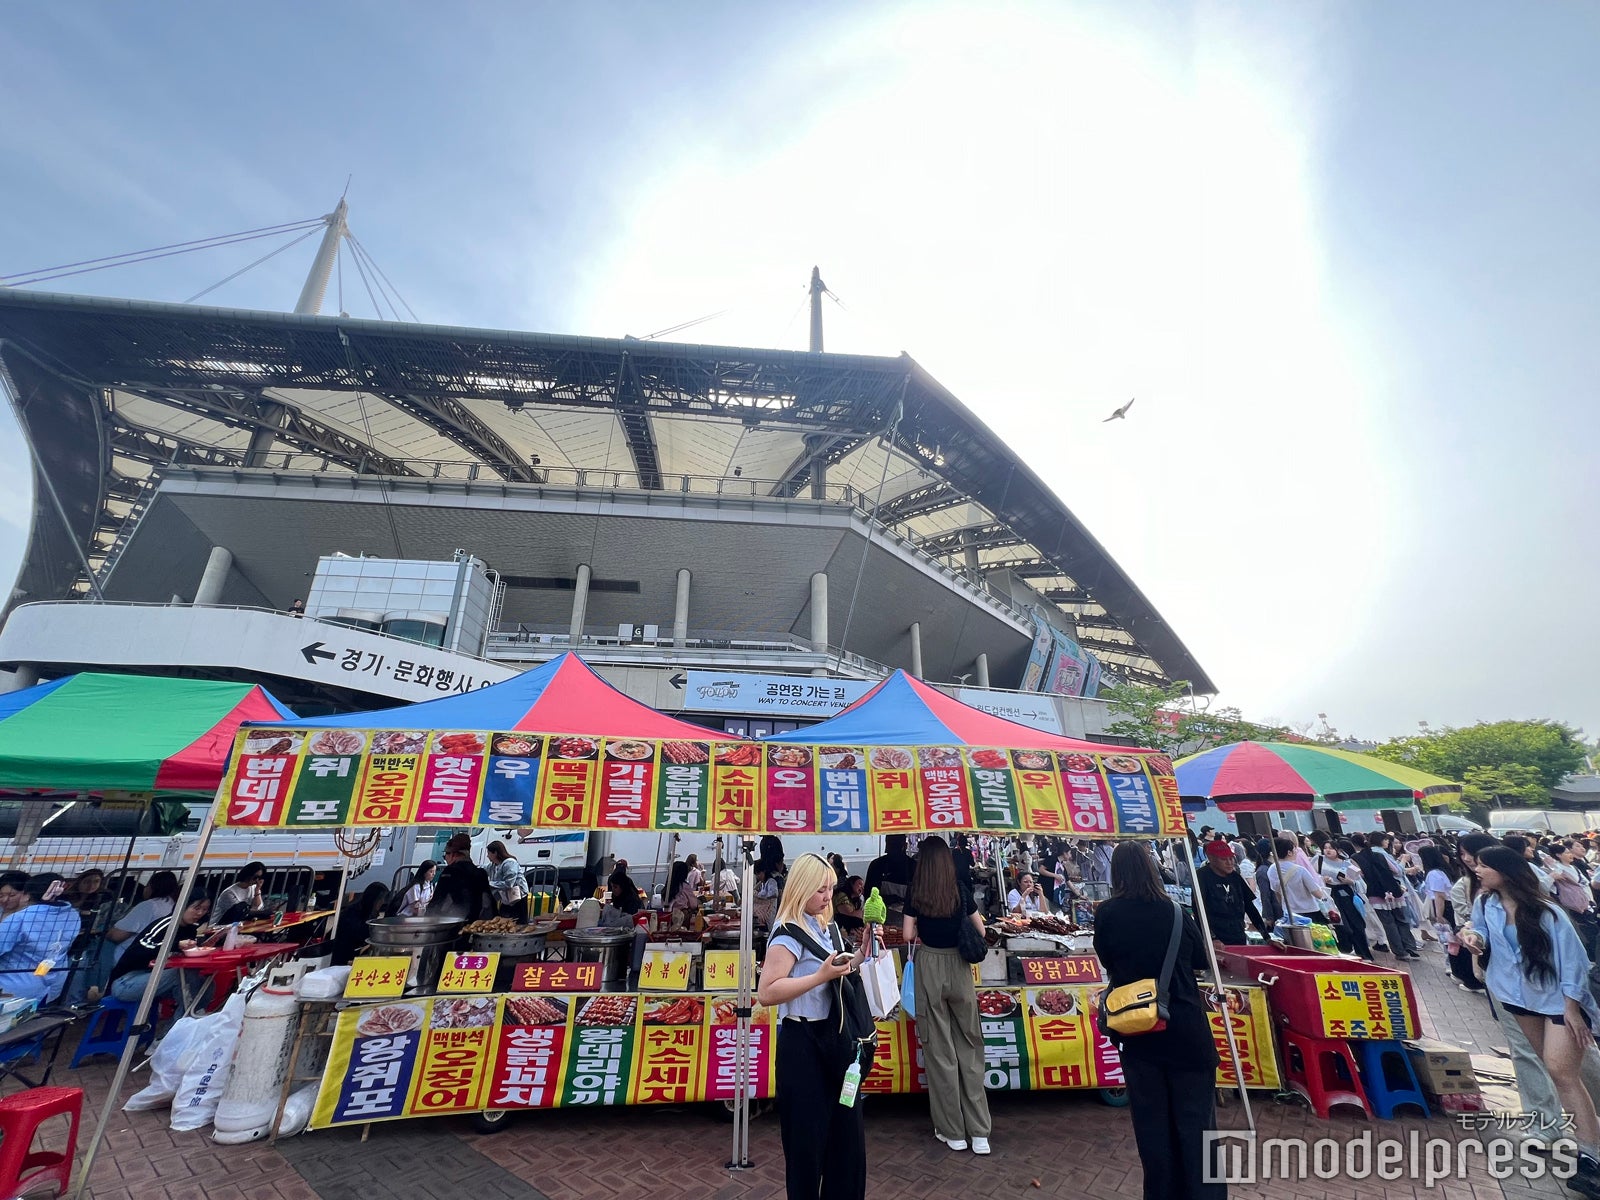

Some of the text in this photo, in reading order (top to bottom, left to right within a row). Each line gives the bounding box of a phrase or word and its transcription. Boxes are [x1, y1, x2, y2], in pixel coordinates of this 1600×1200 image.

[758, 697, 776, 705] WAY
[790, 699, 828, 707] CONCERT
[766, 683, 845, 700] 공연장 가는 길
[231, 757, 287, 822] 번데기
[296, 757, 353, 821] 쥐포
[372, 757, 416, 771] 맥반석
[423, 756, 476, 819] 핫도그
[488, 759, 531, 823] 우동
[545, 762, 589, 823] 떡볶이
[924, 769, 960, 783] 맥반석
[362, 772, 409, 820] 오징어
[605, 763, 648, 825] 가락국수
[660, 765, 703, 828] 왕닭꼬치
[716, 768, 754, 829] 소세지
[772, 769, 807, 830] 오뎅
[825, 771, 861, 829] 번데기
[876, 771, 914, 828] 쥐포
[928, 783, 965, 826] 오징어
[974, 769, 1015, 826] 핫도그
[1022, 772, 1059, 827] 우동
[1067, 774, 1107, 830] 떡볶이
[1112, 776, 1154, 831] 가락국수
[442, 970, 493, 987] 잔치국수
[459, 957, 483, 969] 우동
[522, 966, 596, 988] 찰순대
[1028, 959, 1097, 980] 왕닭꼬치
[648, 1029, 695, 1047] 수제
[1363, 981, 1388, 1039] 음료수
[433, 1029, 485, 1049] 맥반석
[494, 1028, 554, 1106] 생닭꼬치
[568, 1028, 627, 1106] 왕데리야끼
[981, 1021, 1020, 1090] 떡볶이
[1039, 1019, 1082, 1087] 순대
[343, 1038, 411, 1117] 왕쥐포
[421, 1049, 478, 1108] 오징어
[640, 1047, 692, 1104] 소세지
